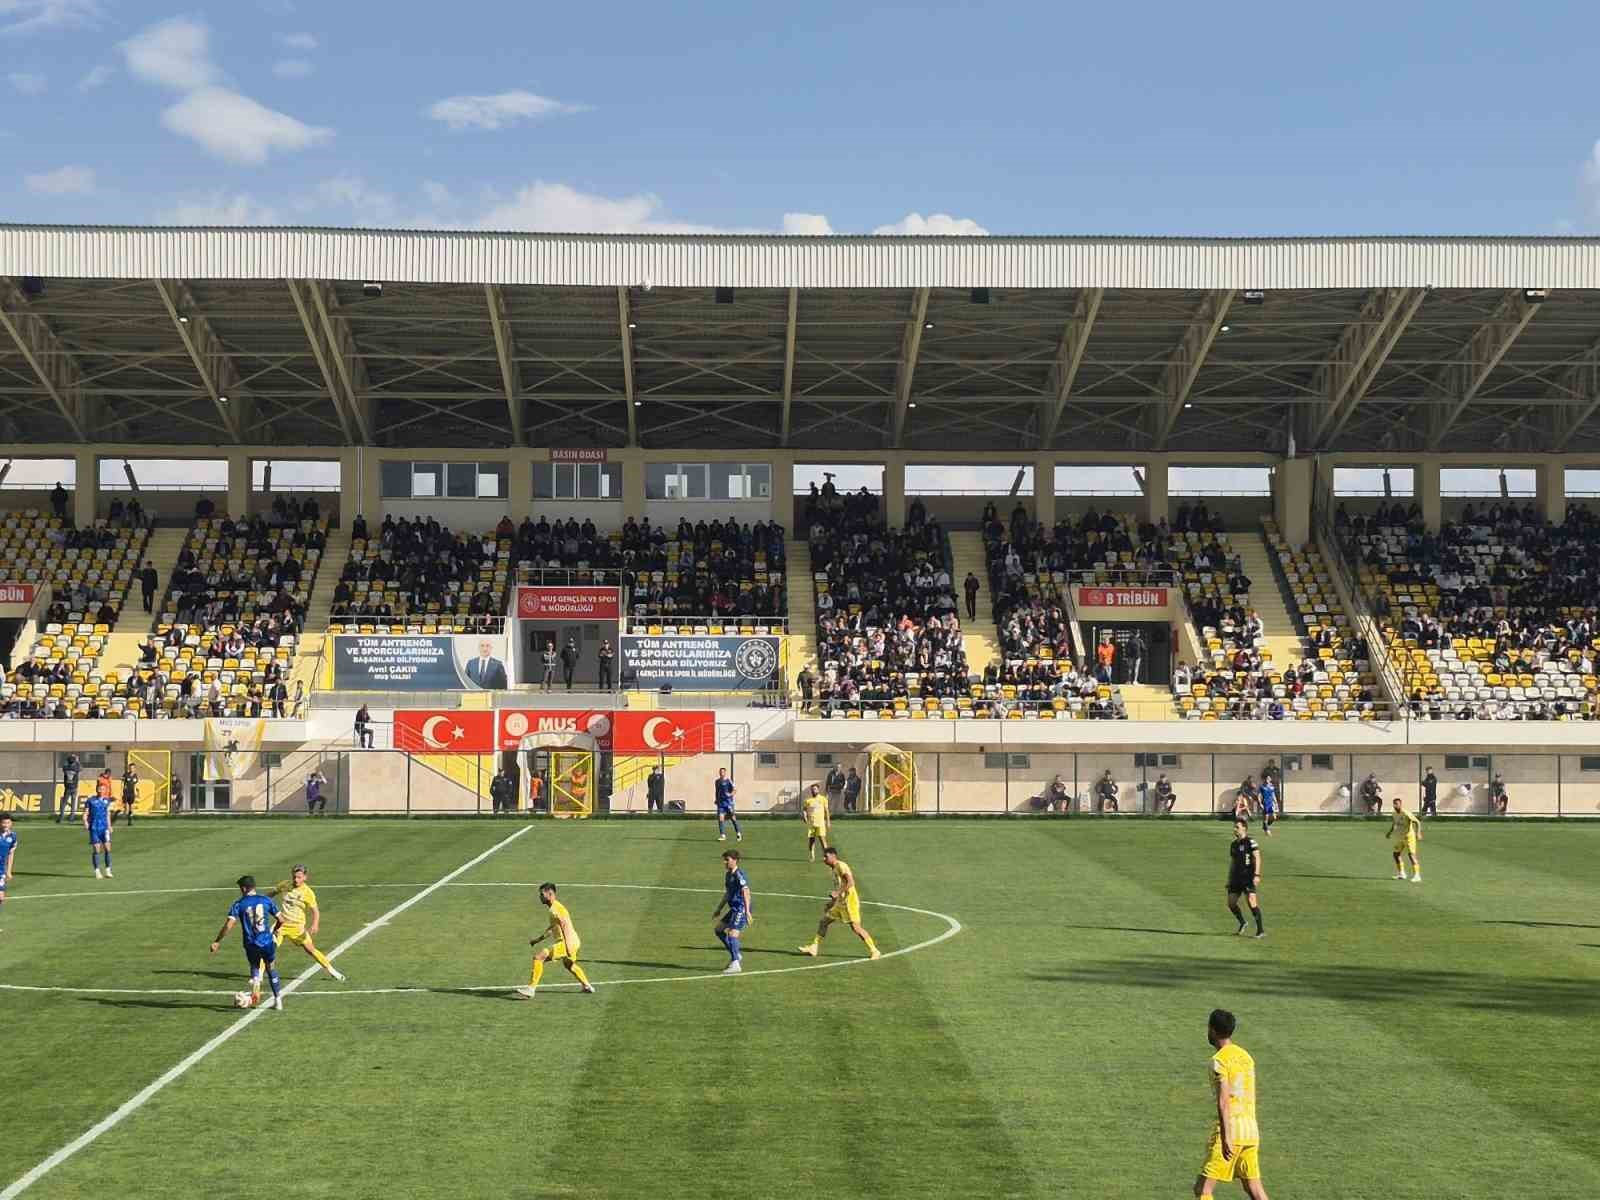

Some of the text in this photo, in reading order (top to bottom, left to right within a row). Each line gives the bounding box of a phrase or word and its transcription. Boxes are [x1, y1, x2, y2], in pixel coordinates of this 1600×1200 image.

[1106, 590, 1159, 605] B TRİBÜN
[357, 638, 432, 647] TÜM ANTRENÖR
[636, 639, 719, 649] TÜM ANTRENÖR
[345, 647, 445, 655] VE SPORCULARIMIZA
[624, 649, 731, 658] VE SPORCULARIMIZA
[353, 656, 395, 665] BAŞARILAR
[629, 658, 727, 668] BAŞARILAR DİLİYORUZ
